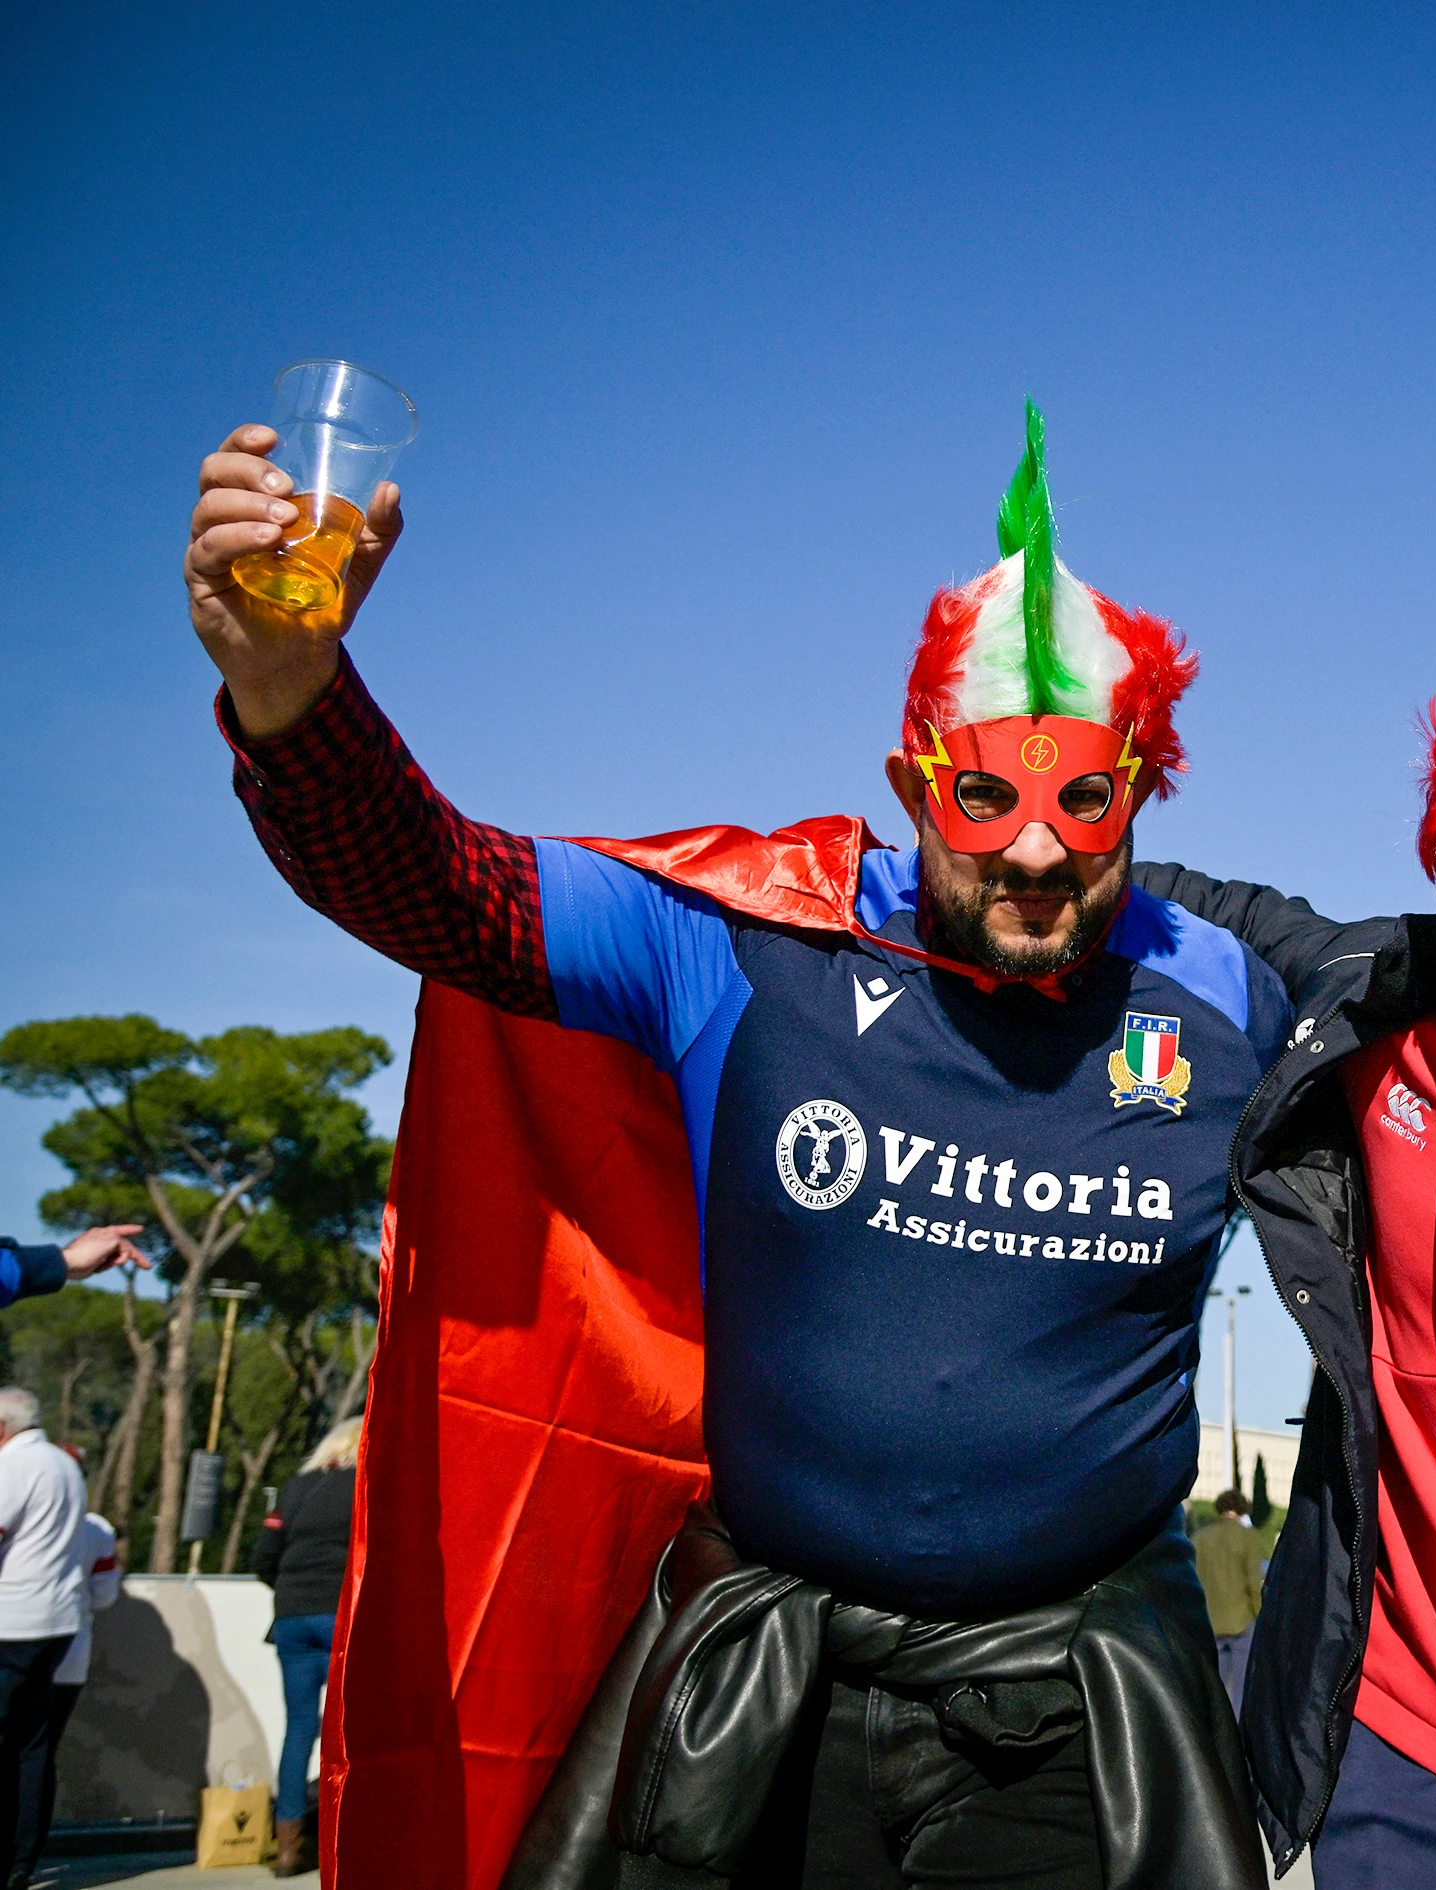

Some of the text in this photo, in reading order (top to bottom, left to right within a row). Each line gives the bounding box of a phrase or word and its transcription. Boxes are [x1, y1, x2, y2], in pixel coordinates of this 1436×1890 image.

[1132, 1017, 1173, 1033] F.I.R.
[1132, 1085, 1166, 1099] ITALIA
[791, 1104, 861, 1146] VITTORIA
[1380, 1113, 1427, 1152] canterbury
[780, 1142, 858, 1205] ASSICURAZIONI
[878, 1125, 1174, 1221] Vittoria
[866, 1198, 1166, 1265] Assicurazioni
